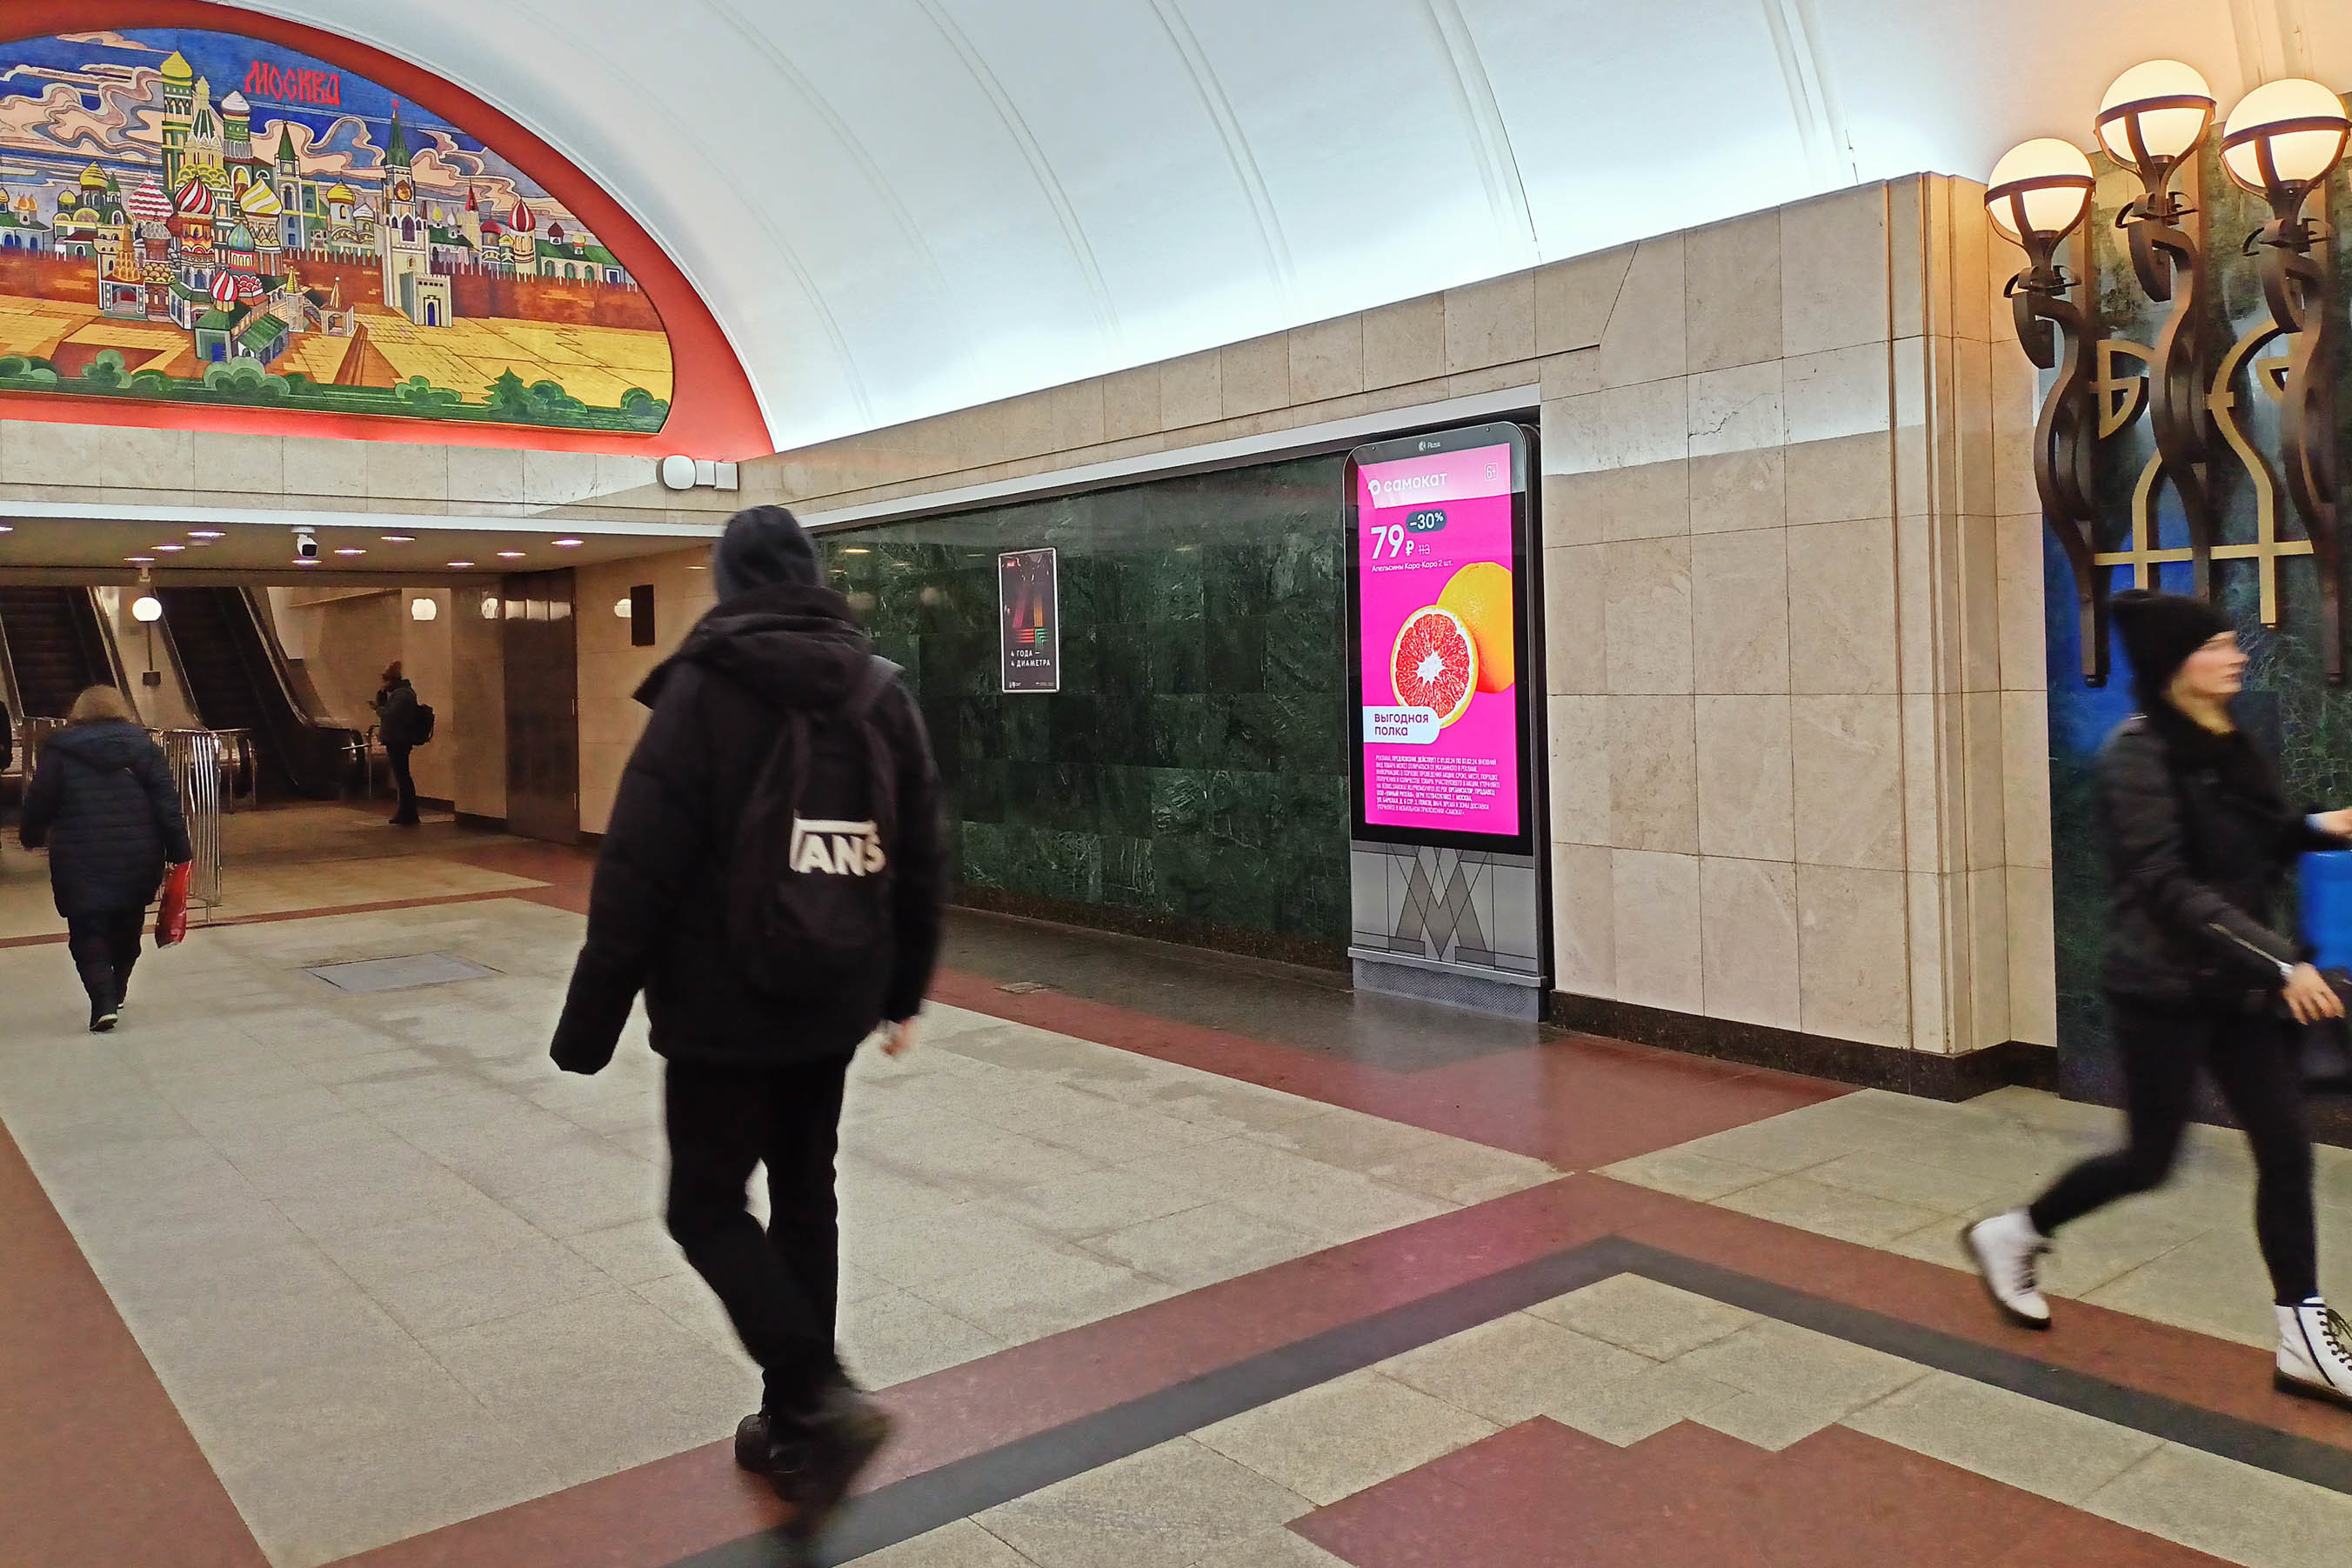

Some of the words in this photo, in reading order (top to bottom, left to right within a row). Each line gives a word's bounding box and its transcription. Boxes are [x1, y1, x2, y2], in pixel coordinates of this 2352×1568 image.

[1485, 465, 1498, 479] 6+
[1383, 471, 1448, 493] самокат
[1409, 511, 1444, 530] -30%
[1371, 564, 1404, 572] Апельсины
[1016, 650, 1033, 658] ГОДА
[1016, 659, 1051, 669] ДИАМЕТРА
[1374, 711, 1429, 724] выгодная
[1374, 725, 1408, 737] полка
